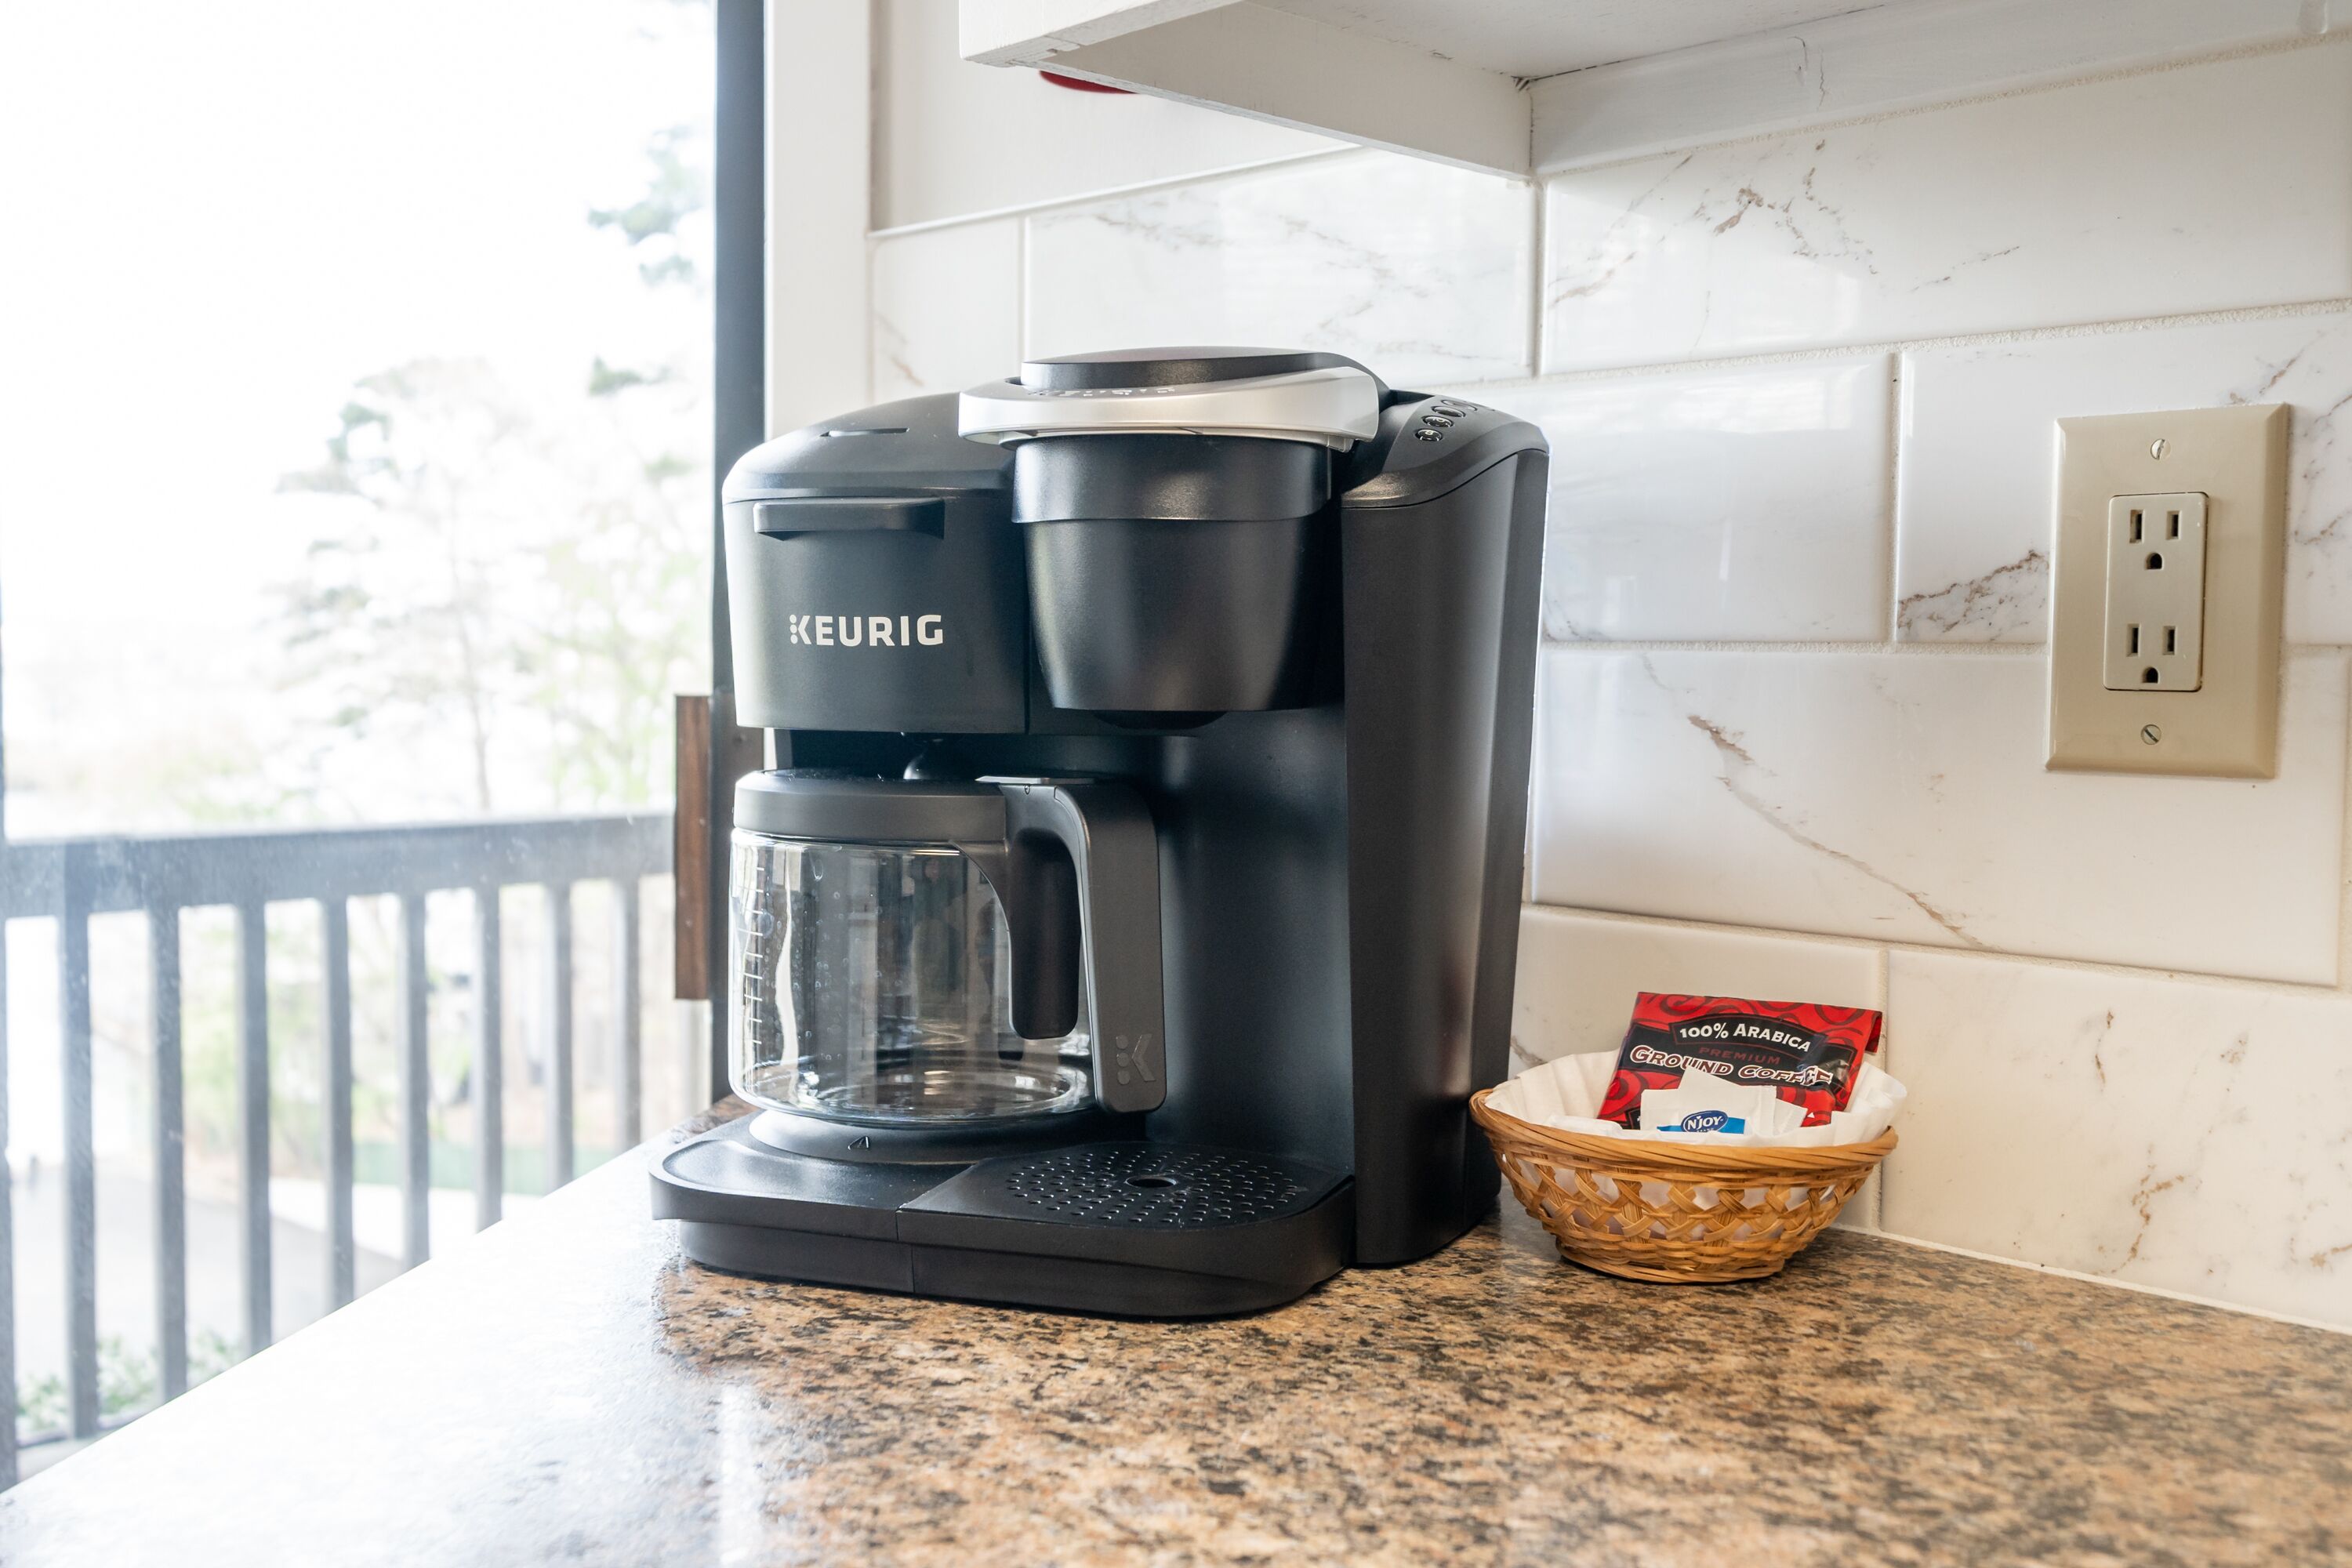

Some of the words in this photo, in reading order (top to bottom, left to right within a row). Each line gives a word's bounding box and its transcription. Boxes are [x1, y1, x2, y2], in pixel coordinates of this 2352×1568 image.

[789, 614, 943, 647] KEURIG
[1679, 1022, 1729, 1039] 100%
[1733, 1023, 1811, 1052] ARABICA
[1630, 1045, 1733, 1076] GROUND
[1698, 1047, 1781, 1065] PREMIUM
